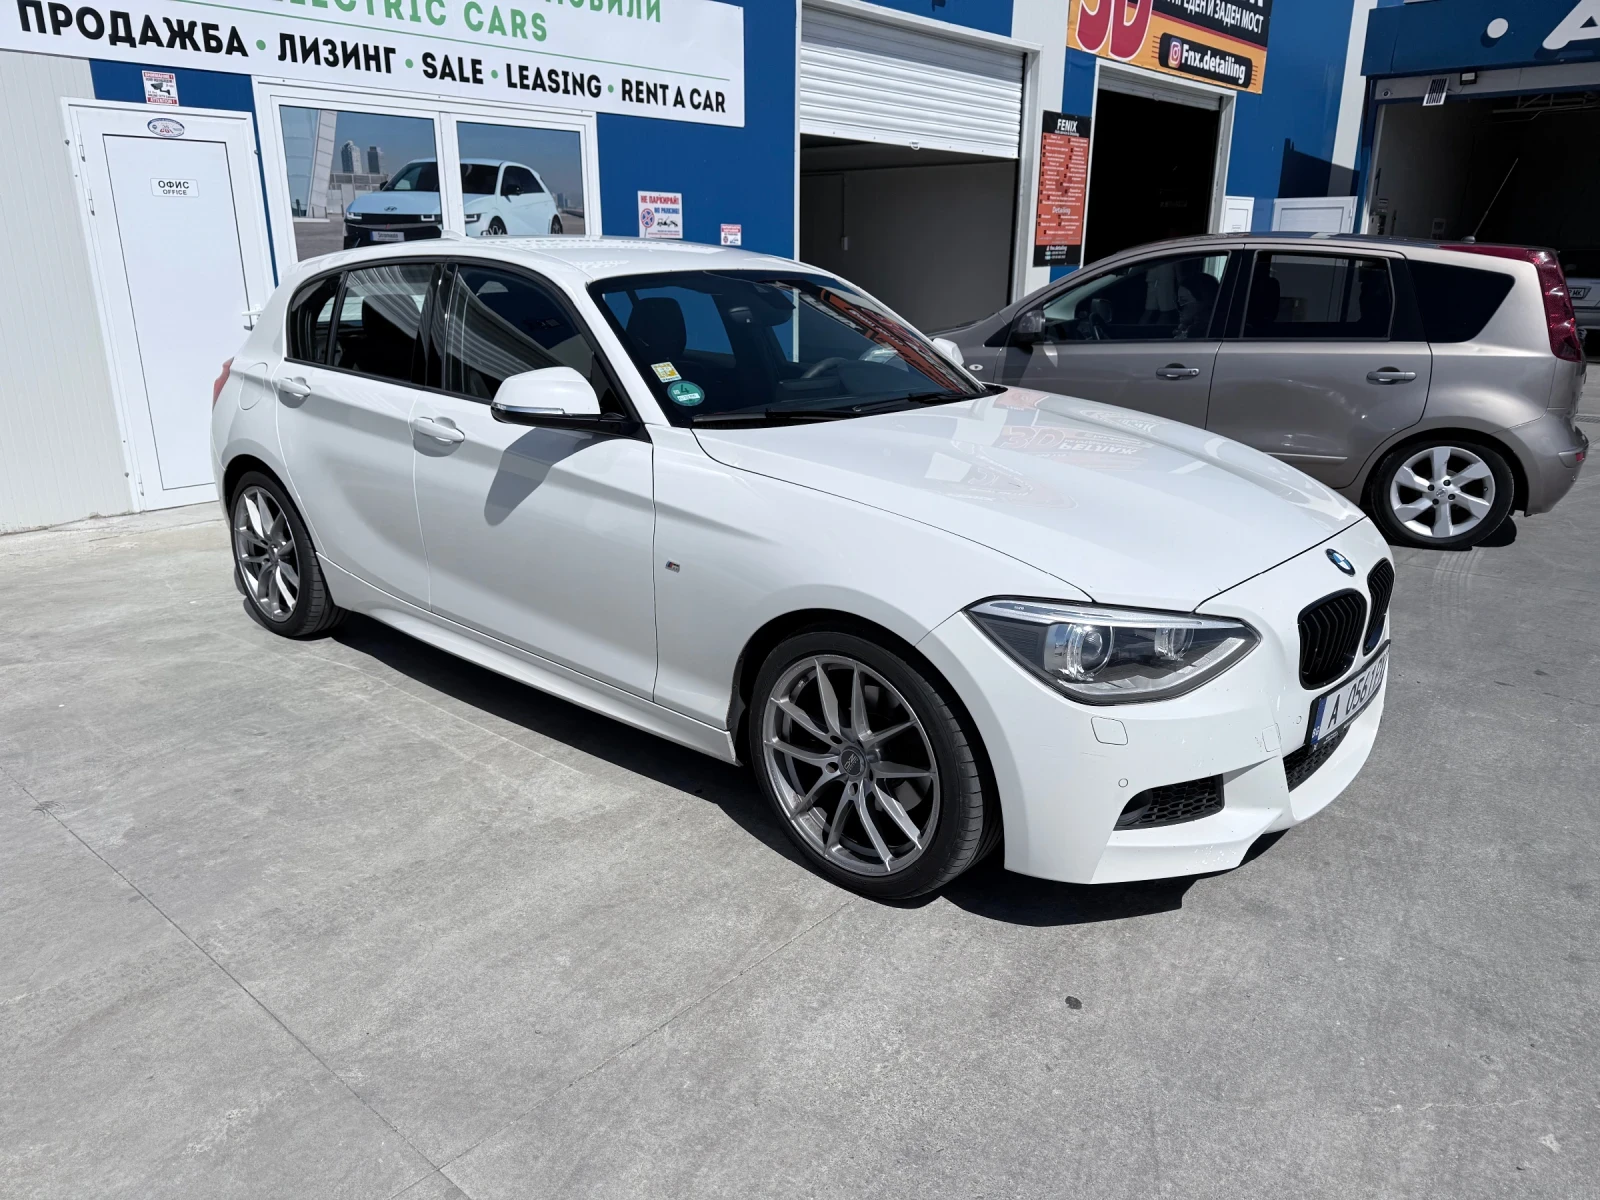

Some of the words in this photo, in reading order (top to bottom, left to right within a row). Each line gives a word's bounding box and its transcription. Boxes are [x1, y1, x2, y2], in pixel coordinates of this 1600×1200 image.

[463, 1, 547, 42] CARS
[1214, 1, 1242, 27] ЗАДЕН
[1241, 9, 1264, 34] МОСТ
[17, 0, 249, 57] ПРОДАЖБА
[277, 32, 396, 74] ЛИЗИНГ
[422, 52, 484, 85] SALE
[506, 63, 602, 98] LEASING
[621, 79, 669, 106] RENT
[673, 86, 686, 109] A
[689, 87, 726, 113] CAR
[1182, 44, 1246, 84] Fnx.detailing
[1057, 119, 1078, 132] FENIX
[158, 180, 190, 189] ОФИС
[680, 384, 689, 393] 4
[1327, 694, 1341, 730] A
